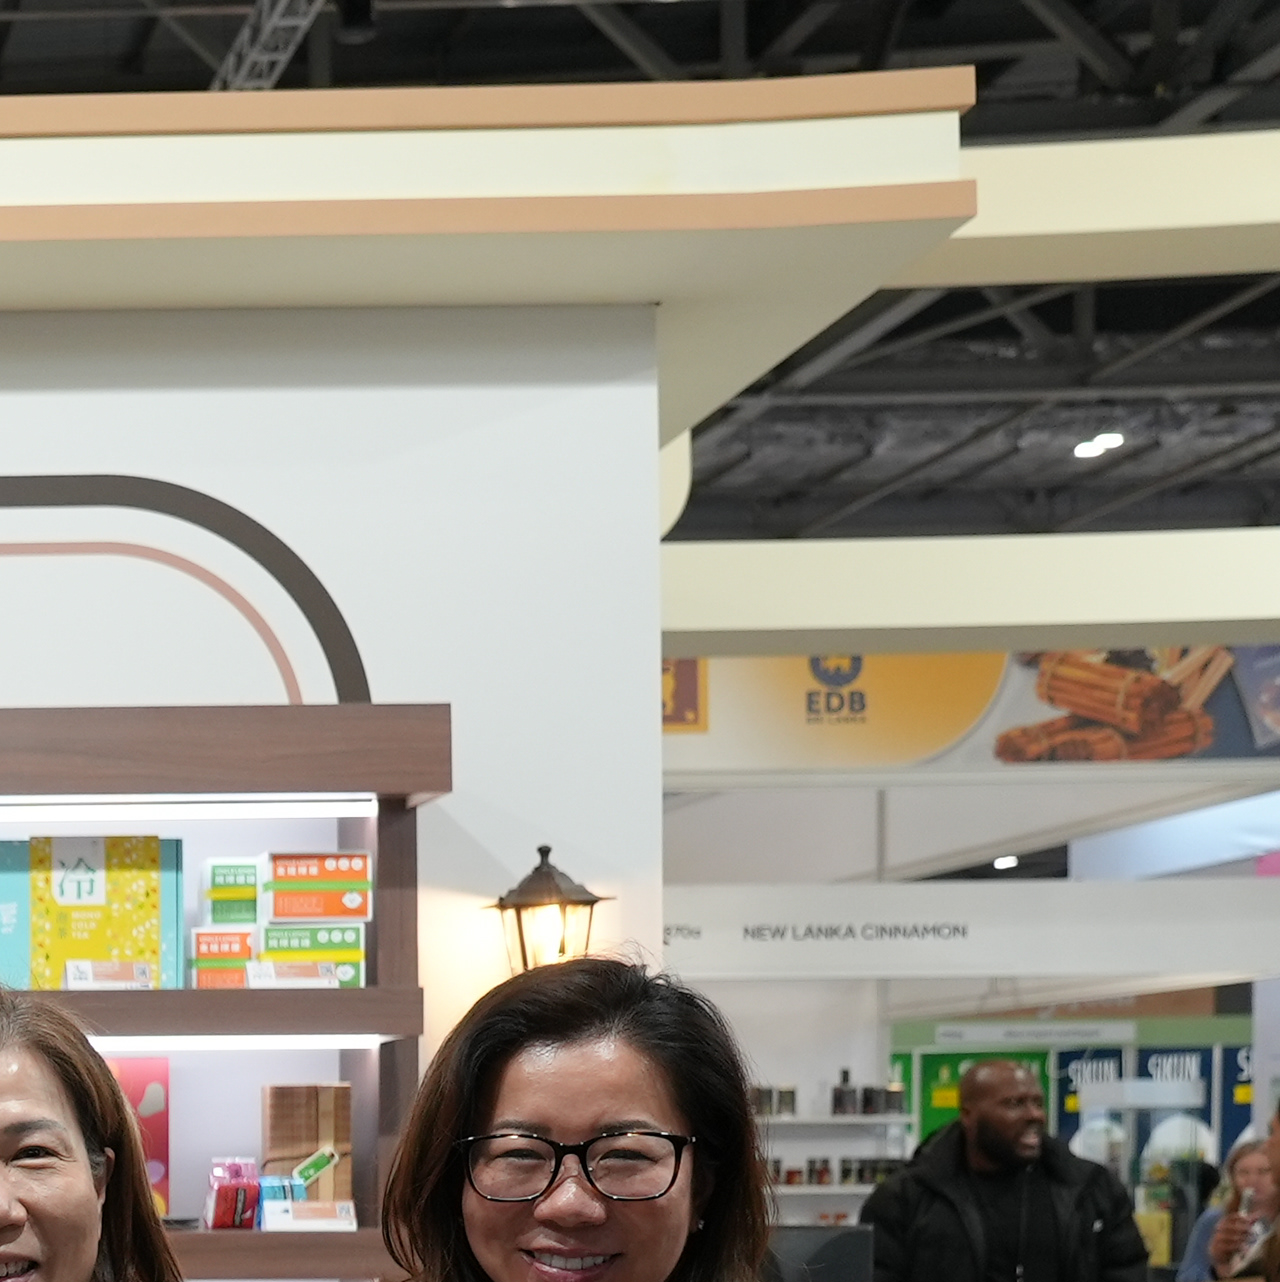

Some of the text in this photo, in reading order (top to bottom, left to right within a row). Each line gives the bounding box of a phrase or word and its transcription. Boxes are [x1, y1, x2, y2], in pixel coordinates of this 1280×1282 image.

[806, 690, 867, 715] EDB
[58, 857, 97, 900] 冷
[743, 923, 968, 940] NEW LANKA CINNAMON
